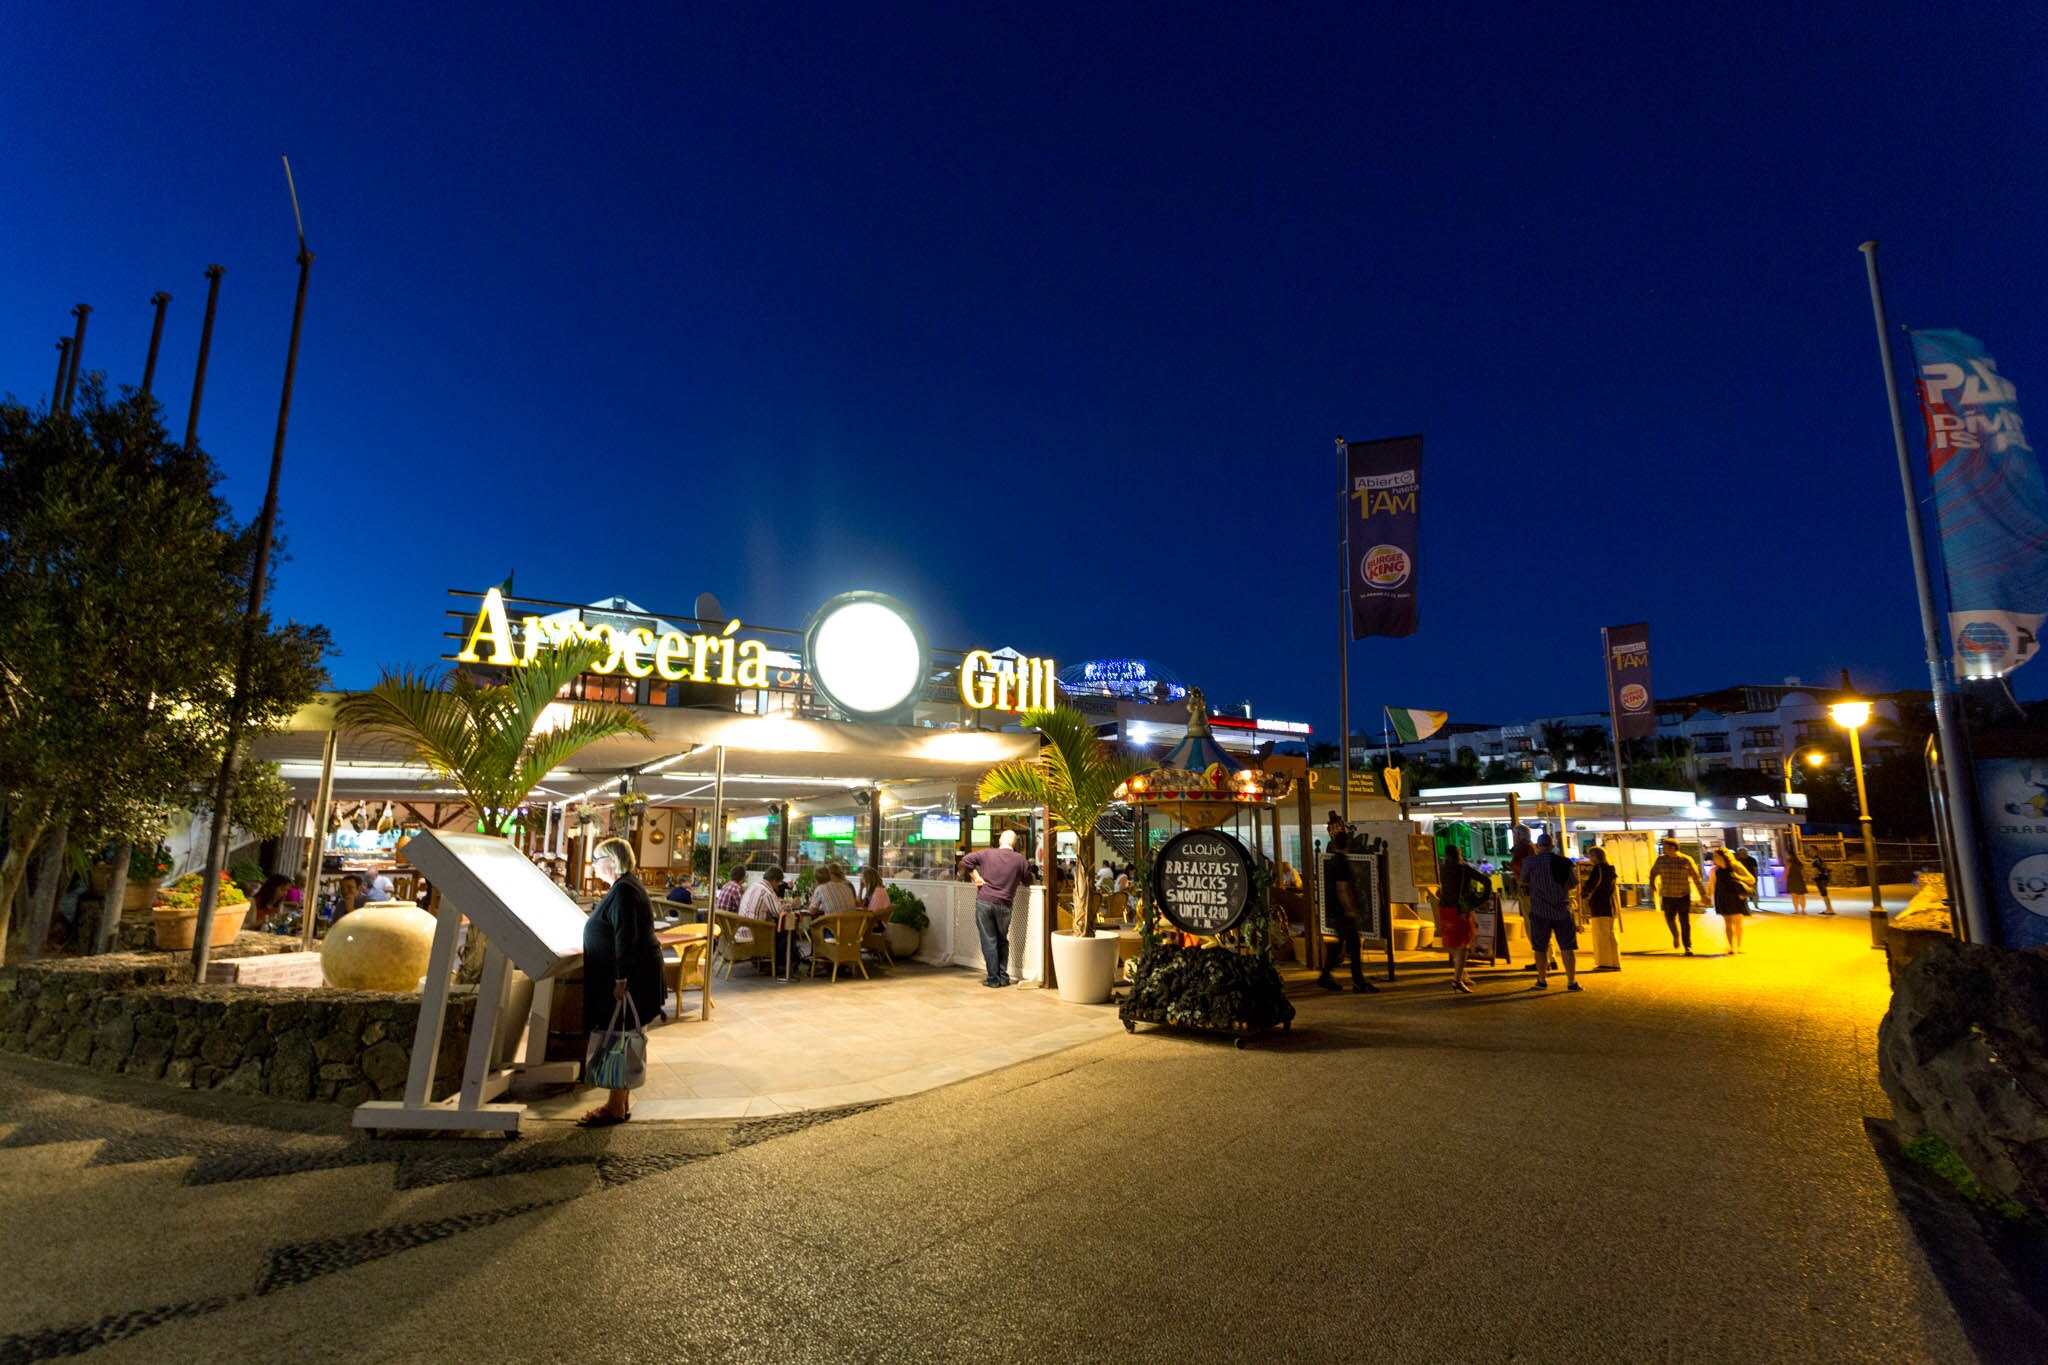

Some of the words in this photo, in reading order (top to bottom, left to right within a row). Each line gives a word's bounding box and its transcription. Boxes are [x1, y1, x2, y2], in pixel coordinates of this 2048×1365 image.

[1367, 553, 1403, 568] BURGER
[1368, 561, 1405, 580] KING
[960, 649, 1056, 713] Grill
[1165, 860, 1239, 876] BREAKFAST
